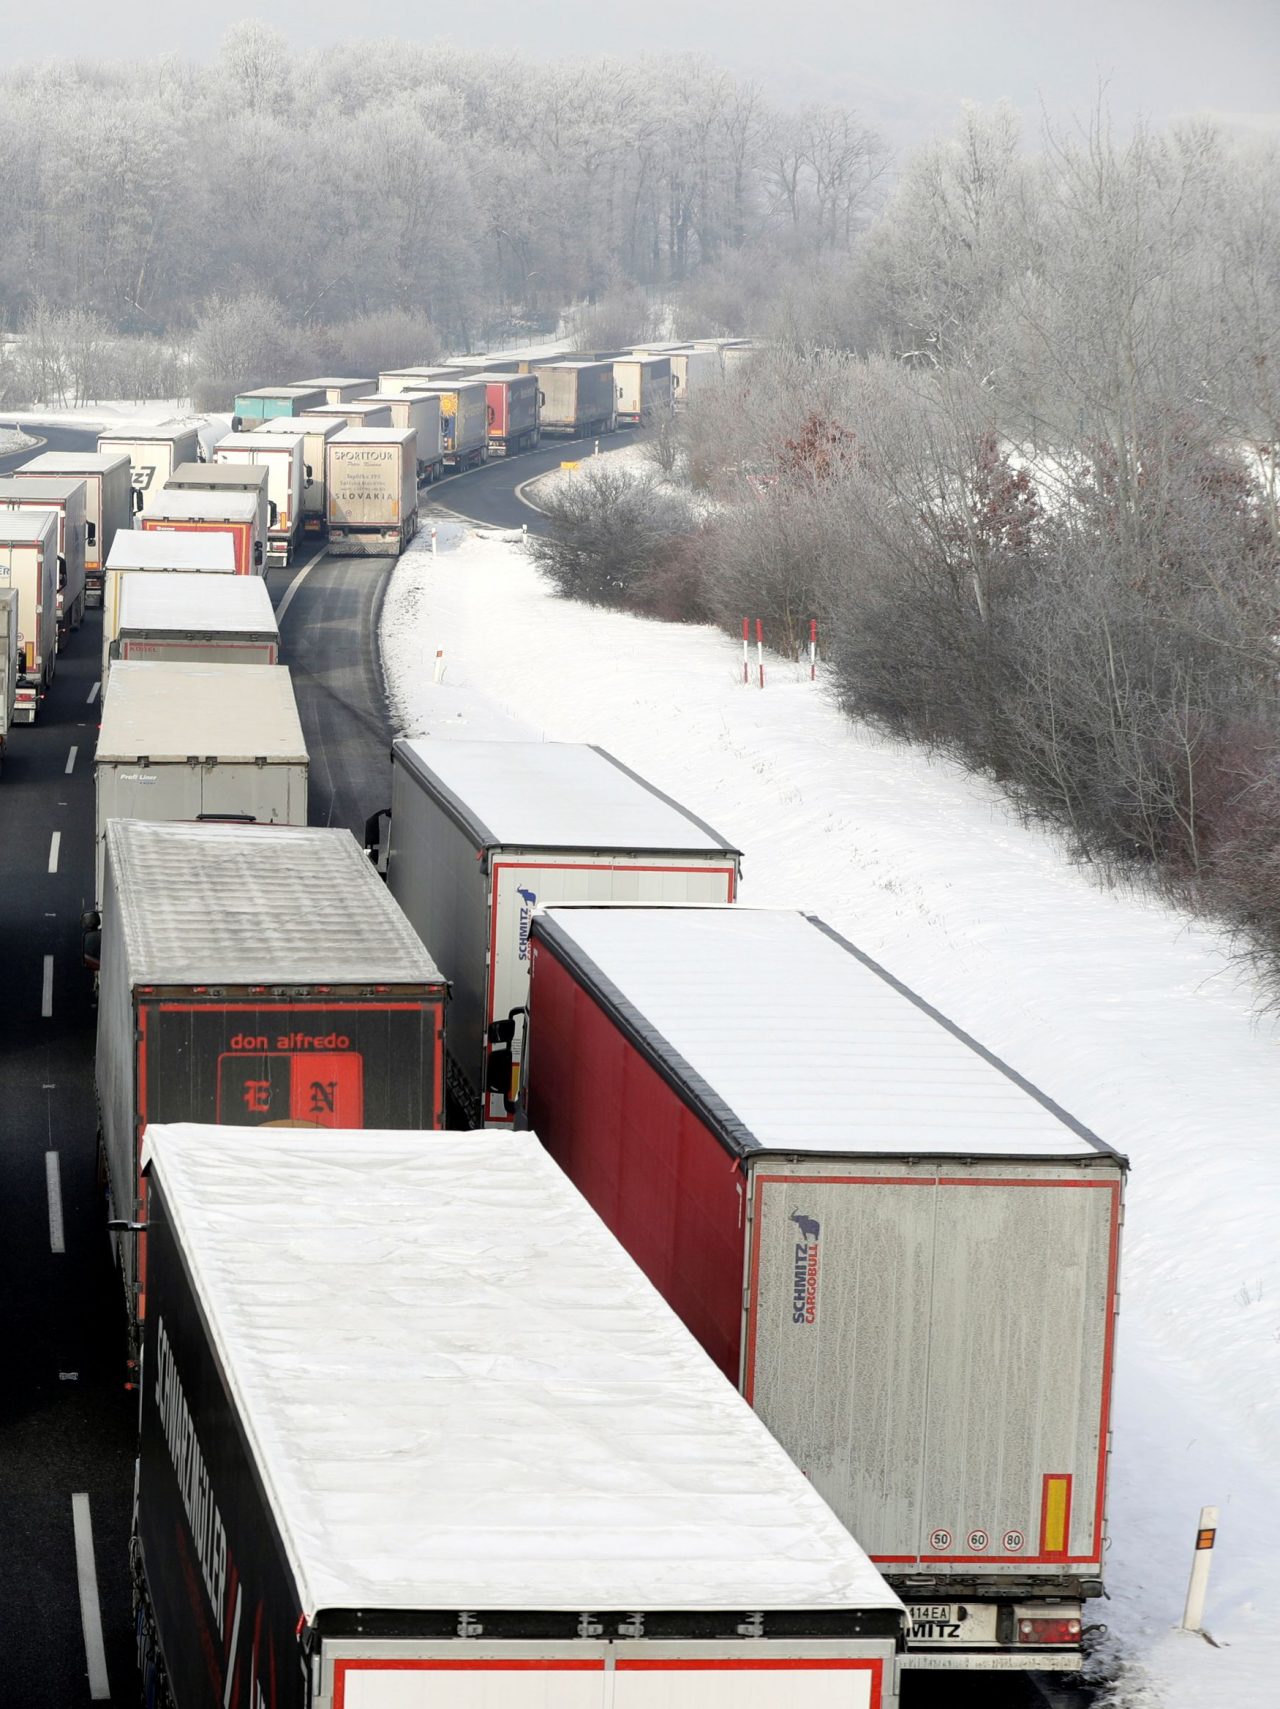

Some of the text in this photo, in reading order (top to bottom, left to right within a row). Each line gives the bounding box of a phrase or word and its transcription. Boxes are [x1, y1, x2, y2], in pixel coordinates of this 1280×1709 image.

[335, 451, 393, 462] SPORTTOUR
[336, 492, 393, 500] SLOVAKIA
[519, 907, 529, 961] SCHMITZ
[230, 1033, 349, 1049] don alfredo
[793, 1243, 808, 1324] SCHMITZ
[806, 1243, 818, 1324] CARGOBULL
[155, 1315, 228, 1643] SCHWARZMÜLLER
[934, 1534, 948, 1545] 50
[971, 1535, 985, 1545] 60
[1007, 1535, 1020, 1546] 80
